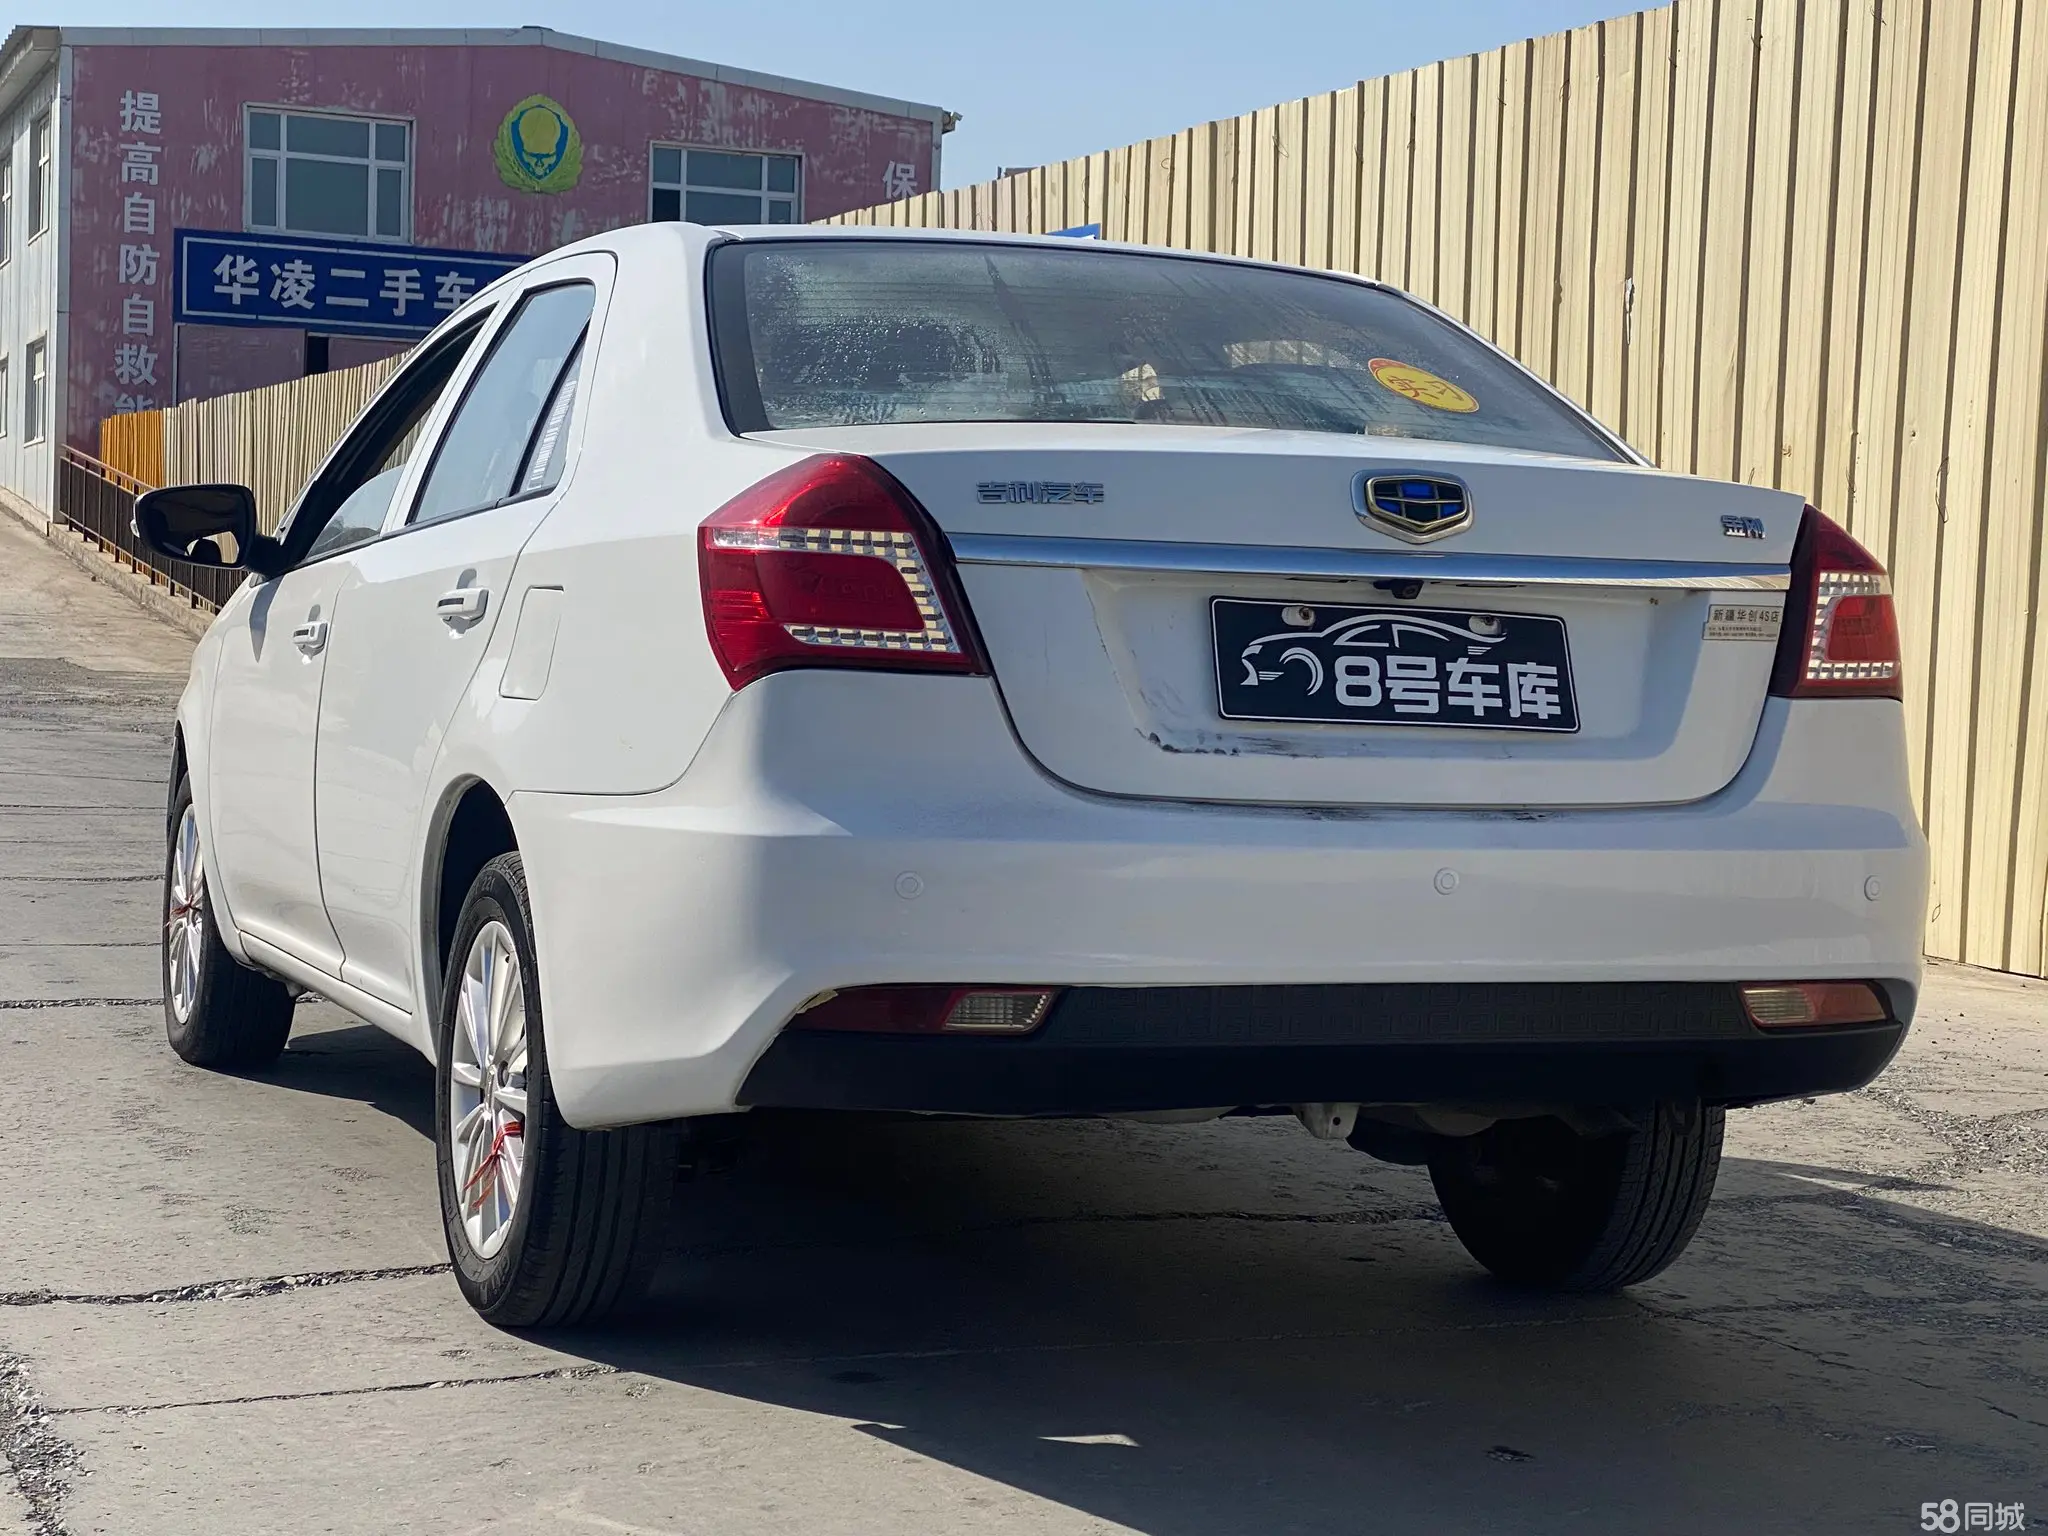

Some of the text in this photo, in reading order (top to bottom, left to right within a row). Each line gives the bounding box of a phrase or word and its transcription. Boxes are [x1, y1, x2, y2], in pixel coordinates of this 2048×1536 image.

[213, 254, 475, 317] 华凌二手车
[977, 481, 1104, 504] 吉利汽车
[1334, 655, 1561, 719] 8号车库
